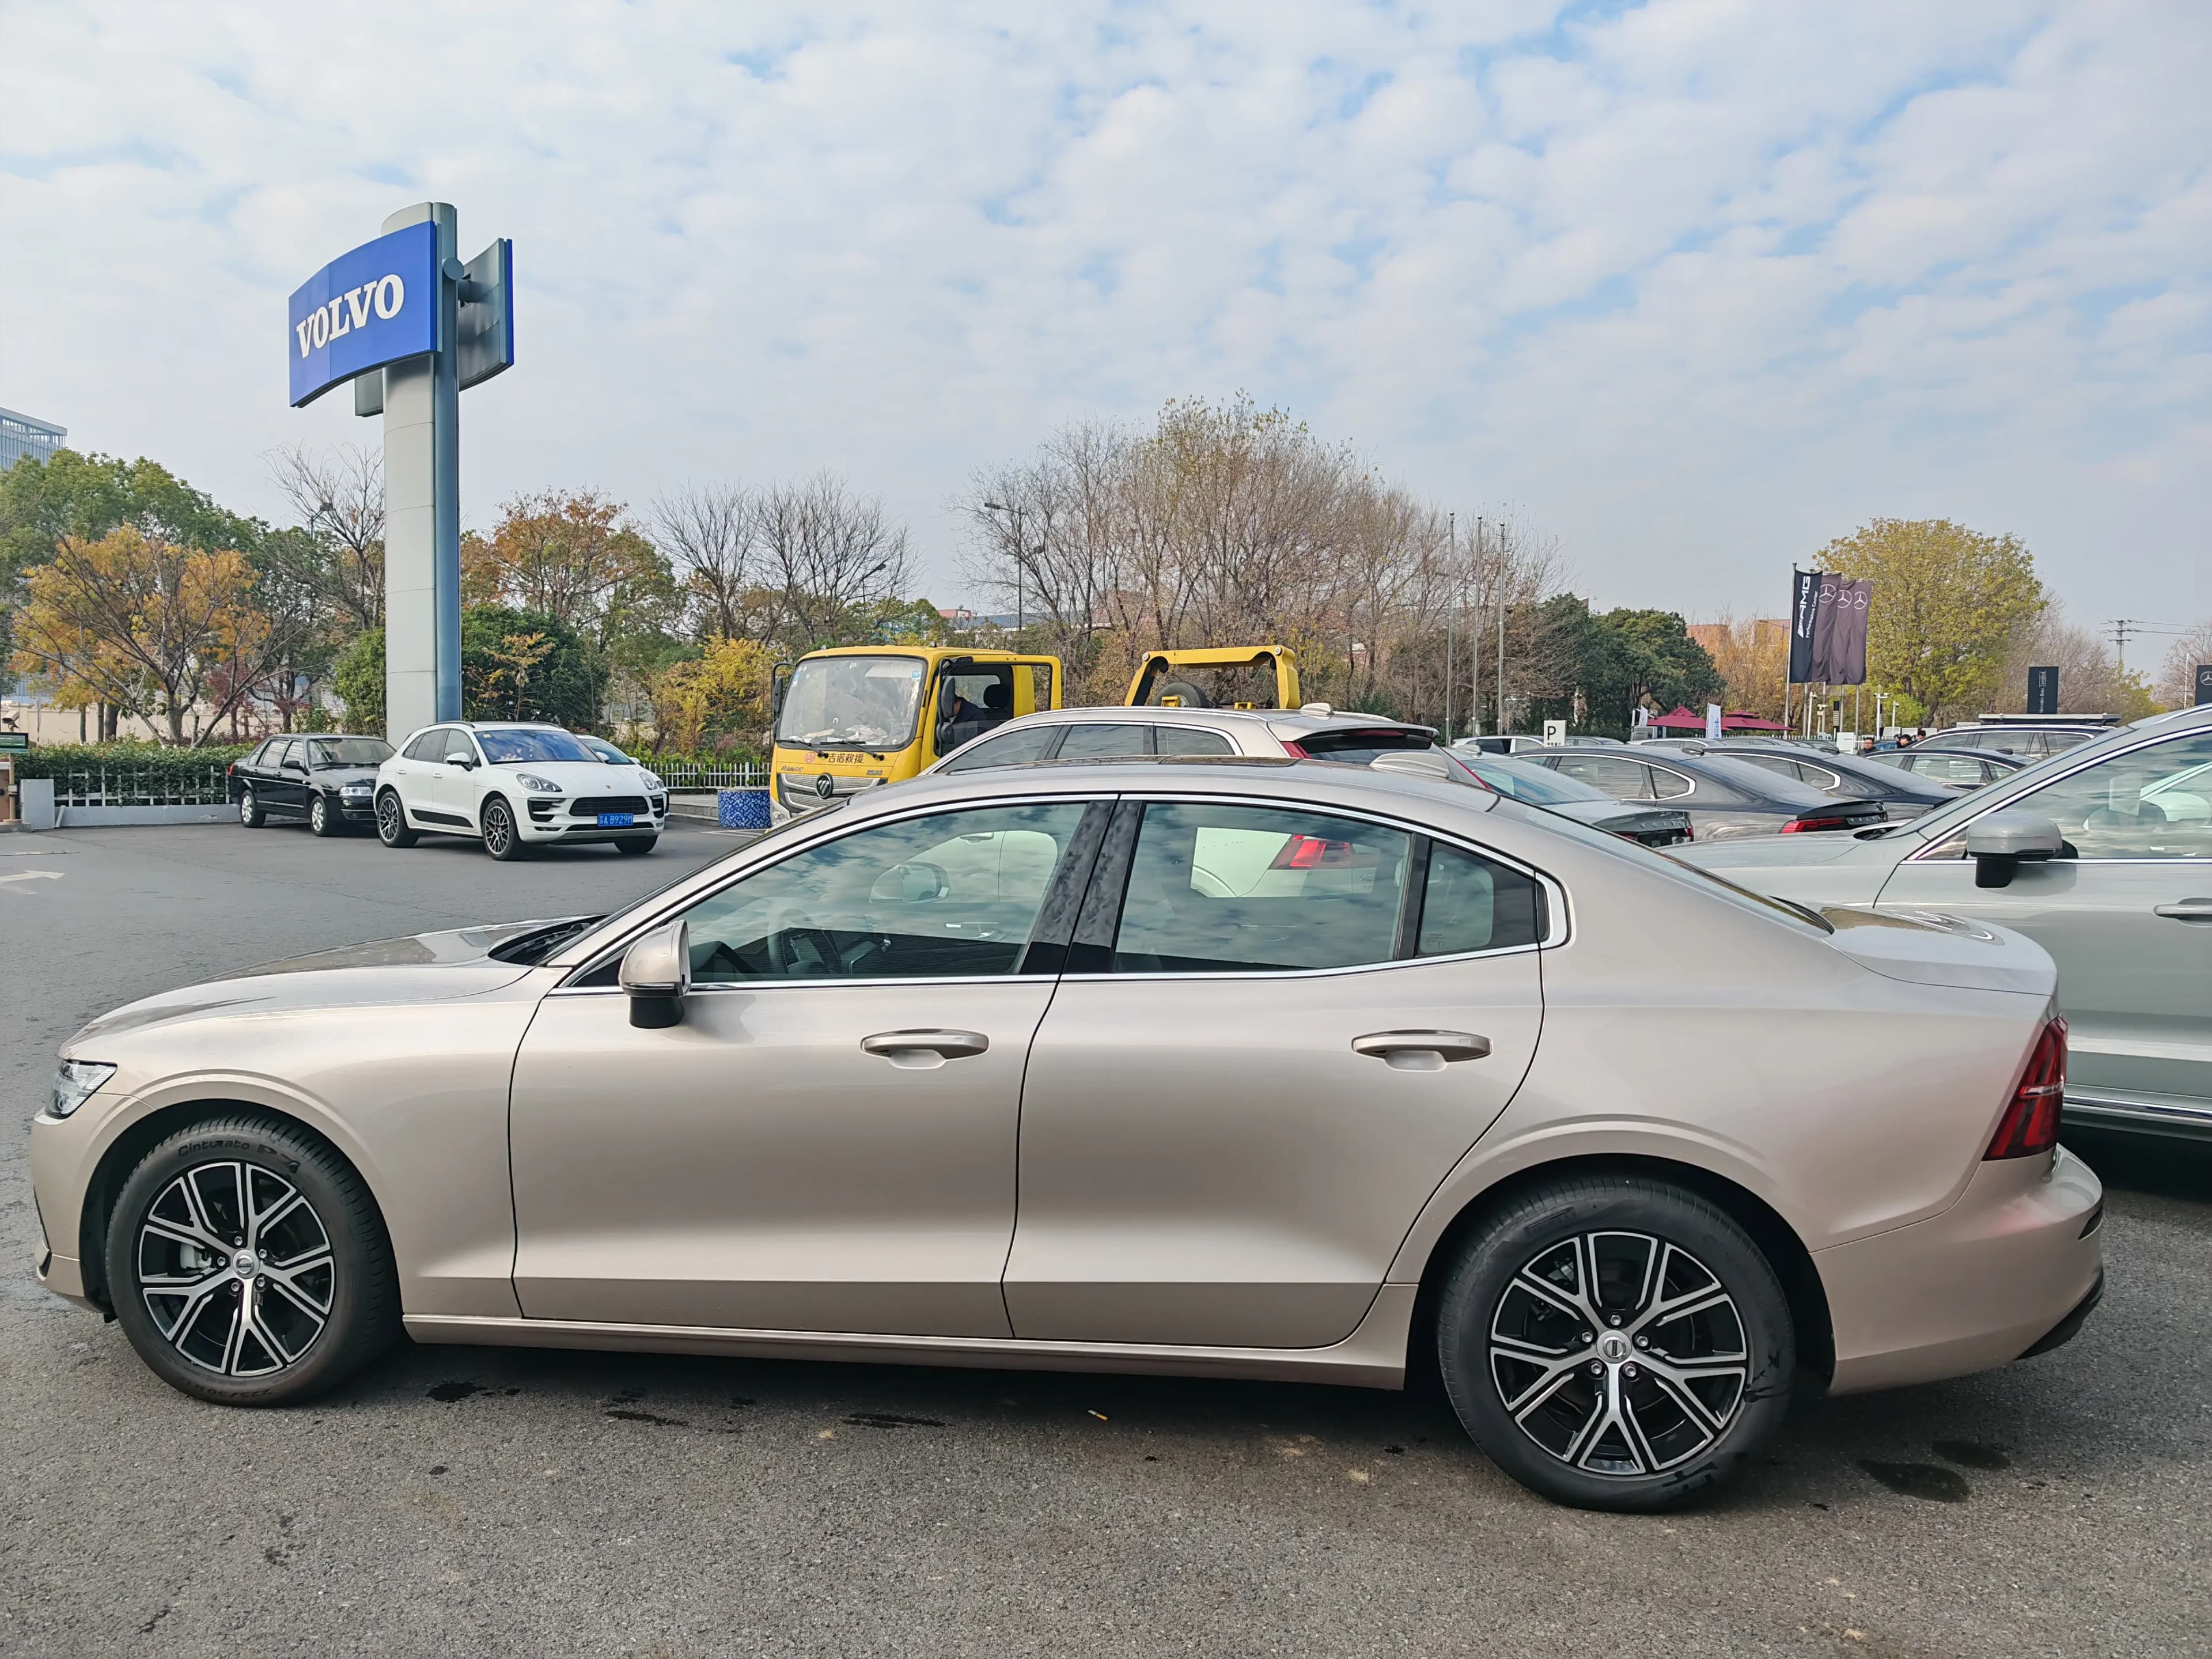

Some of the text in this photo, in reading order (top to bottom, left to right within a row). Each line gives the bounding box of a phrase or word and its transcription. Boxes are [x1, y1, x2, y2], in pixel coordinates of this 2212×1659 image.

[296, 274, 404, 358] VOLVO
[1799, 575, 1811, 620] AMG
[1547, 726, 1556, 740] P
[828, 752, 864, 764] 吉诺救援
[178, 1139, 250, 1157] Cinturato
